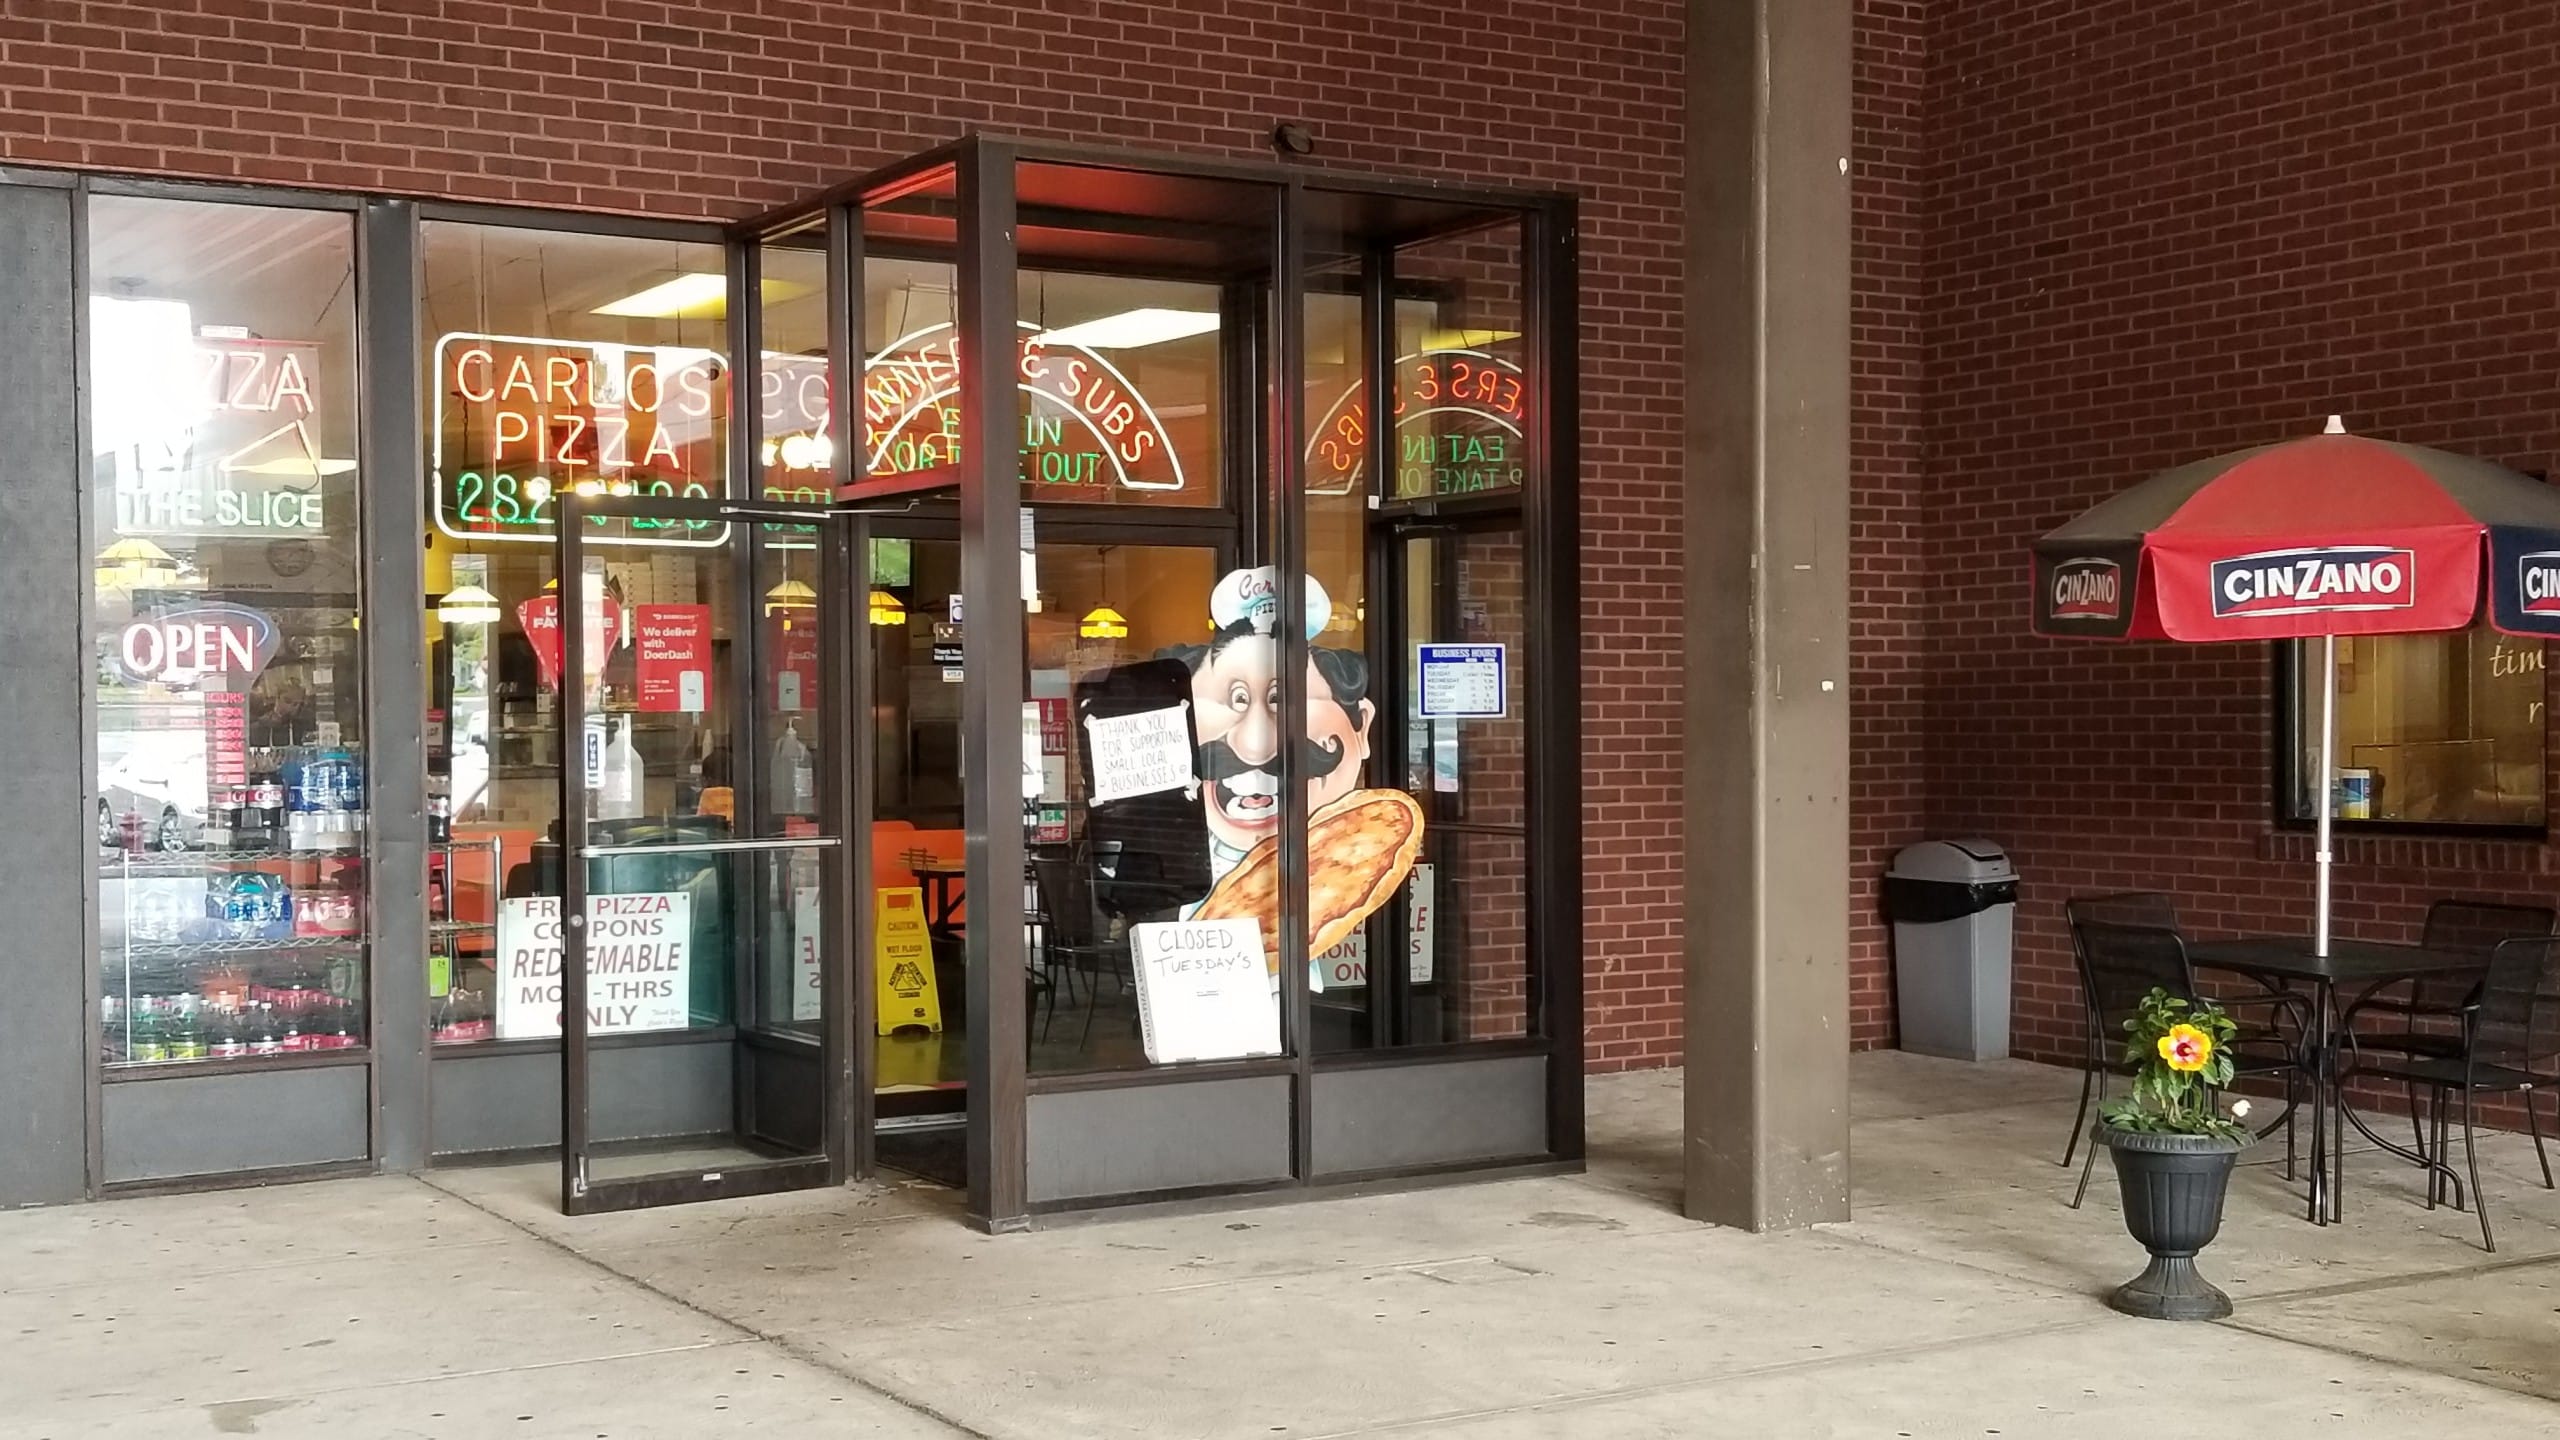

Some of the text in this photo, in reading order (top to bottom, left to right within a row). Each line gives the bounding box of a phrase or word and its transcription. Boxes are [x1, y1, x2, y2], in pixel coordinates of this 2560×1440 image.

[457, 349, 711, 417] CARLOS
[1058, 360, 1155, 463] SUBS
[493, 411, 681, 469] PIZZA
[1043, 451, 1101, 483] OUT
[120, 488, 324, 529] THE SLICE
[2055, 568, 2116, 606] CINZANO
[2223, 559, 2402, 603] CINZANO
[1255, 602, 1274, 616] PIZ
[643, 626, 697, 638] We deliver
[643, 638, 666, 648] with
[122, 621, 255, 678] OPEN
[643, 650, 693, 660] DoorDash
[1096, 713, 1167, 738] THANK YOU
[1102, 728, 1183, 758] FOR SUPPORTING
[1104, 749, 1168, 775] SMALL LOCAL
[1110, 764, 1177, 792] BUSINESSES
[525, 895, 672, 918] FR PIZZA
[533, 917, 664, 940] COPONS
[887, 921, 920, 931] CAUTION
[1158, 928, 1233, 952] CLOSED
[512, 942, 682, 979] REDEMABLE
[1152, 951, 1251, 976] TUESDAY'S
[520, 985, 563, 1004] MO
